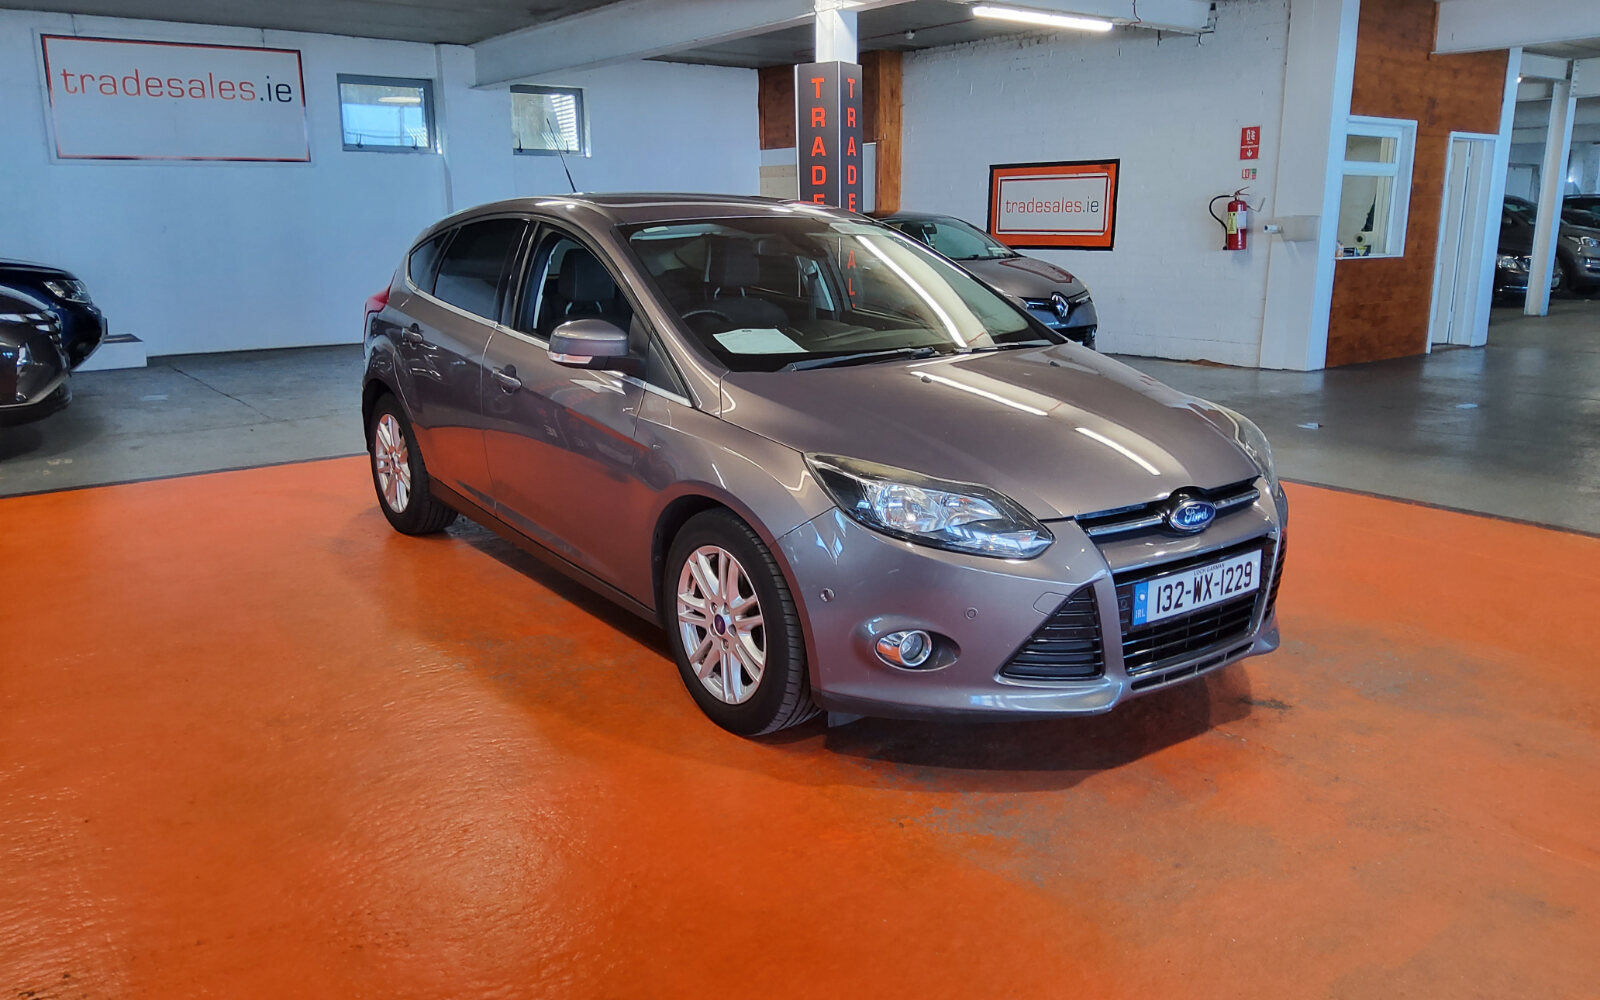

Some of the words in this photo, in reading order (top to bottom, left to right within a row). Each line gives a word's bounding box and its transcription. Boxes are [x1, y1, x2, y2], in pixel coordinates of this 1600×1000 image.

[60, 68, 293, 103] tradesales.ie
[1005, 196, 1099, 213] tradesales.ie
[1184, 505, 1209, 524] Ford
[1156, 561, 1253, 614] 132-WX-1229
